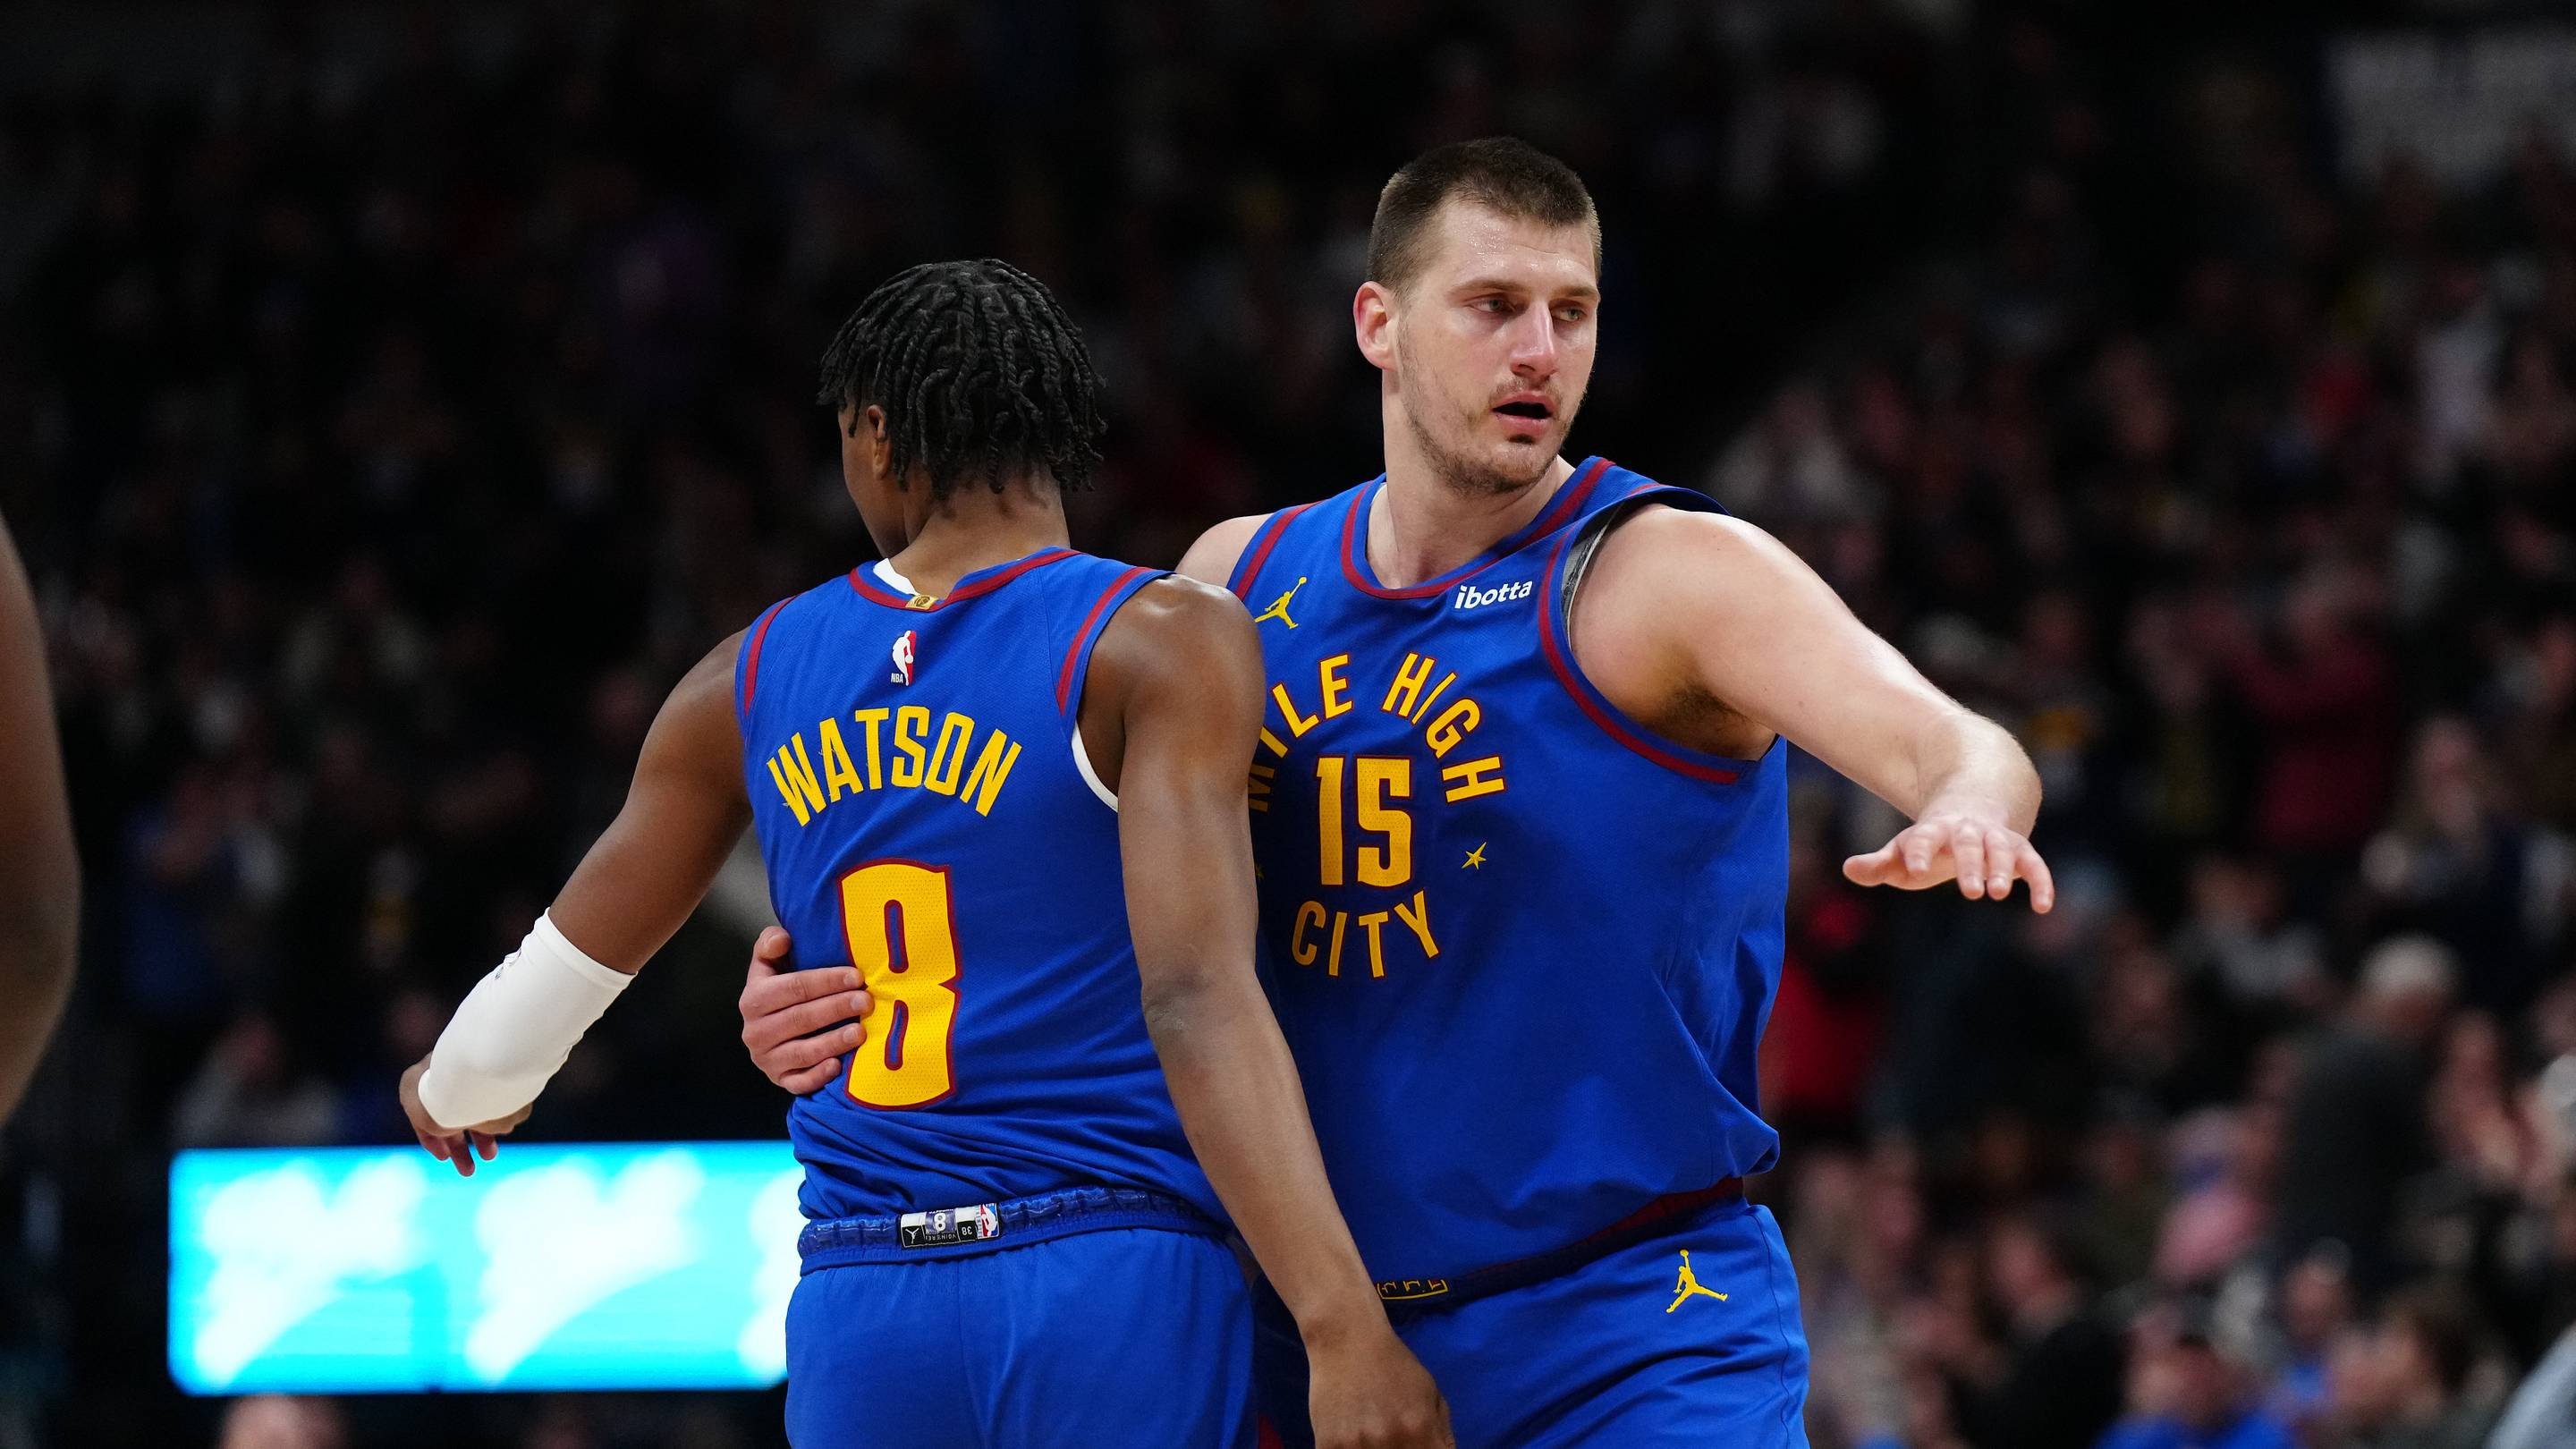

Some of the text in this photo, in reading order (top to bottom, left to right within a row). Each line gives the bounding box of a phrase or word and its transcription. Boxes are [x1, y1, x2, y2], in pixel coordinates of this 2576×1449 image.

[1453, 580, 1533, 610] ibotta
[891, 673, 903, 683] NBA
[1381, 651, 1507, 804] HIGH
[767, 705, 1021, 826] WATSON
[1316, 754, 1414, 888] 15
[836, 858, 962, 1111] 8
[1291, 889, 1440, 979] CITY
[933, 1212, 946, 1232] 8
